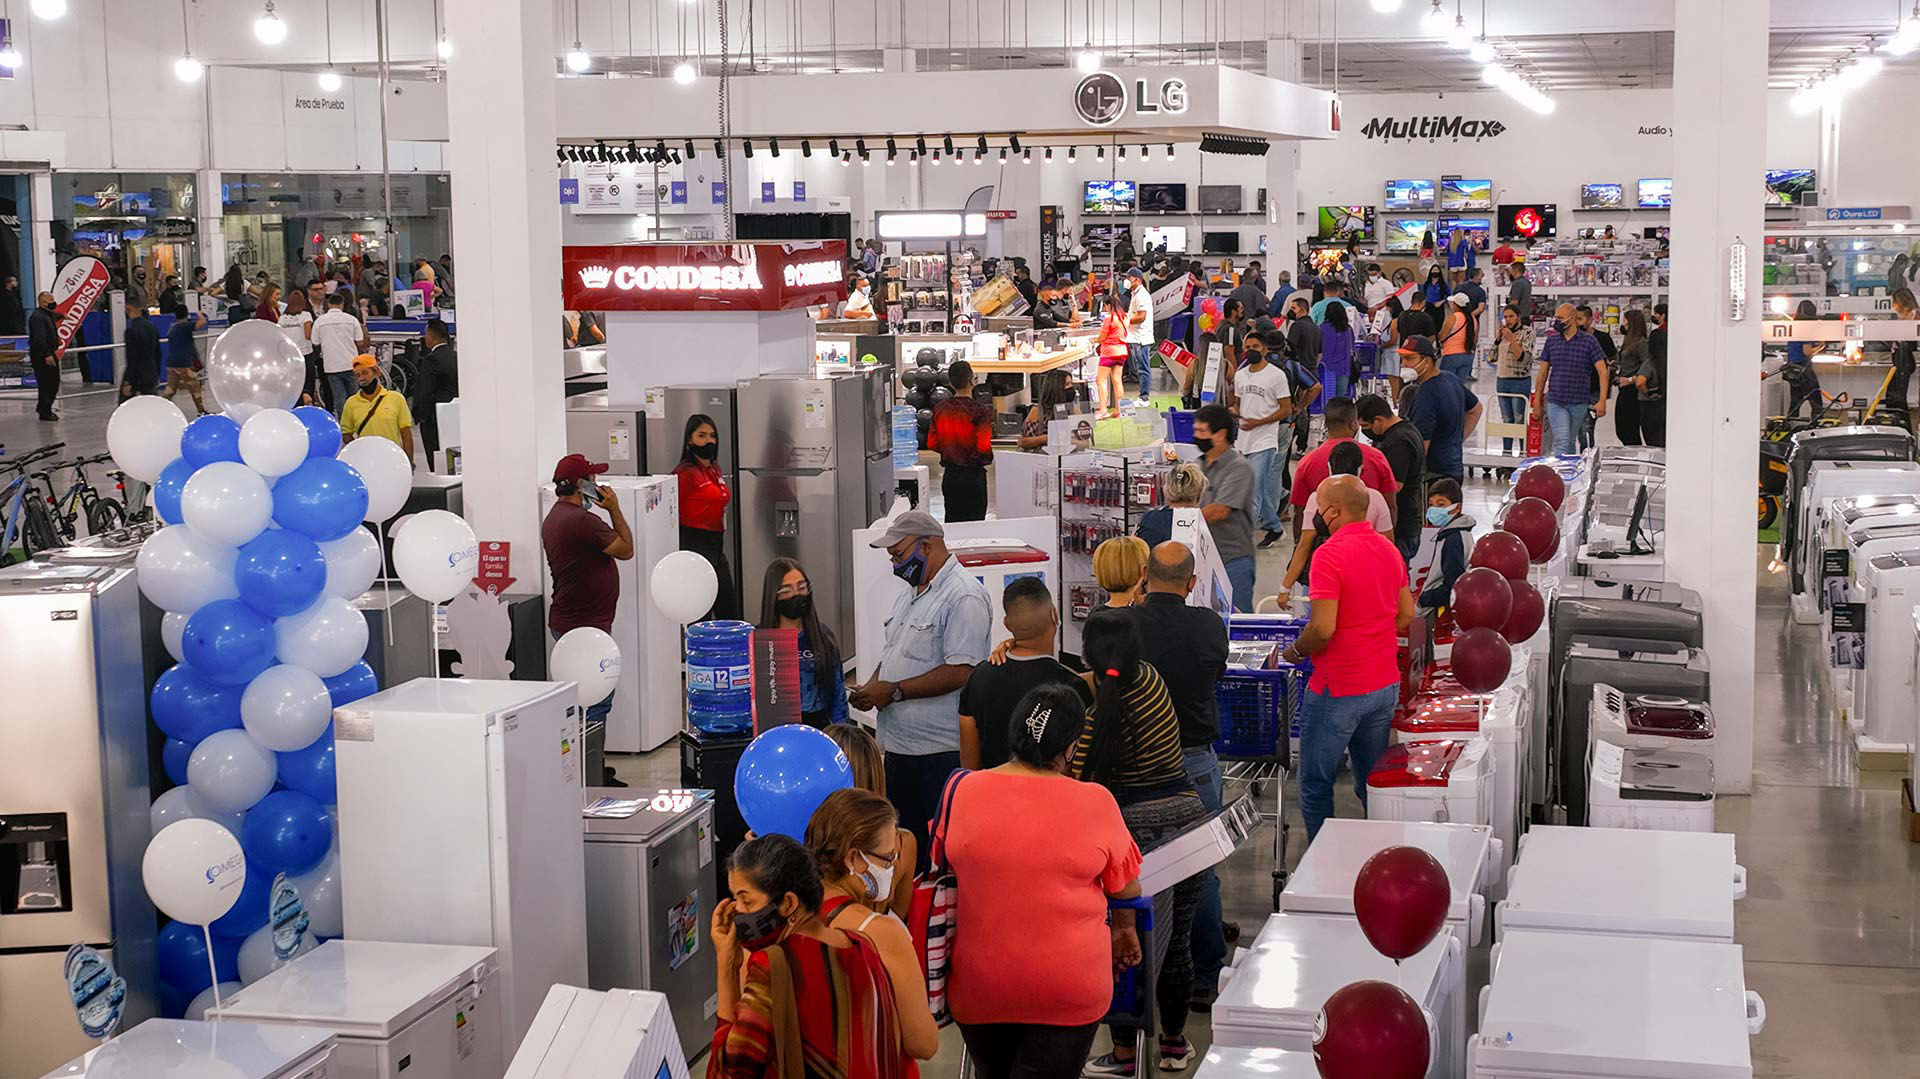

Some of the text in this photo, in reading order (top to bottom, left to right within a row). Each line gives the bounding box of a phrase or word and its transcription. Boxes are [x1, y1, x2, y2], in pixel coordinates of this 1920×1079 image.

[313, 98, 321, 109] de
[322, 98, 344, 110] Prueba
[1136, 79, 1186, 114] LG
[1368, 116, 1497, 139] MultiMax
[1638, 126, 1667, 136] Audio
[615, 265, 763, 291] CONDESA
[715, 670, 728, 683] 12
